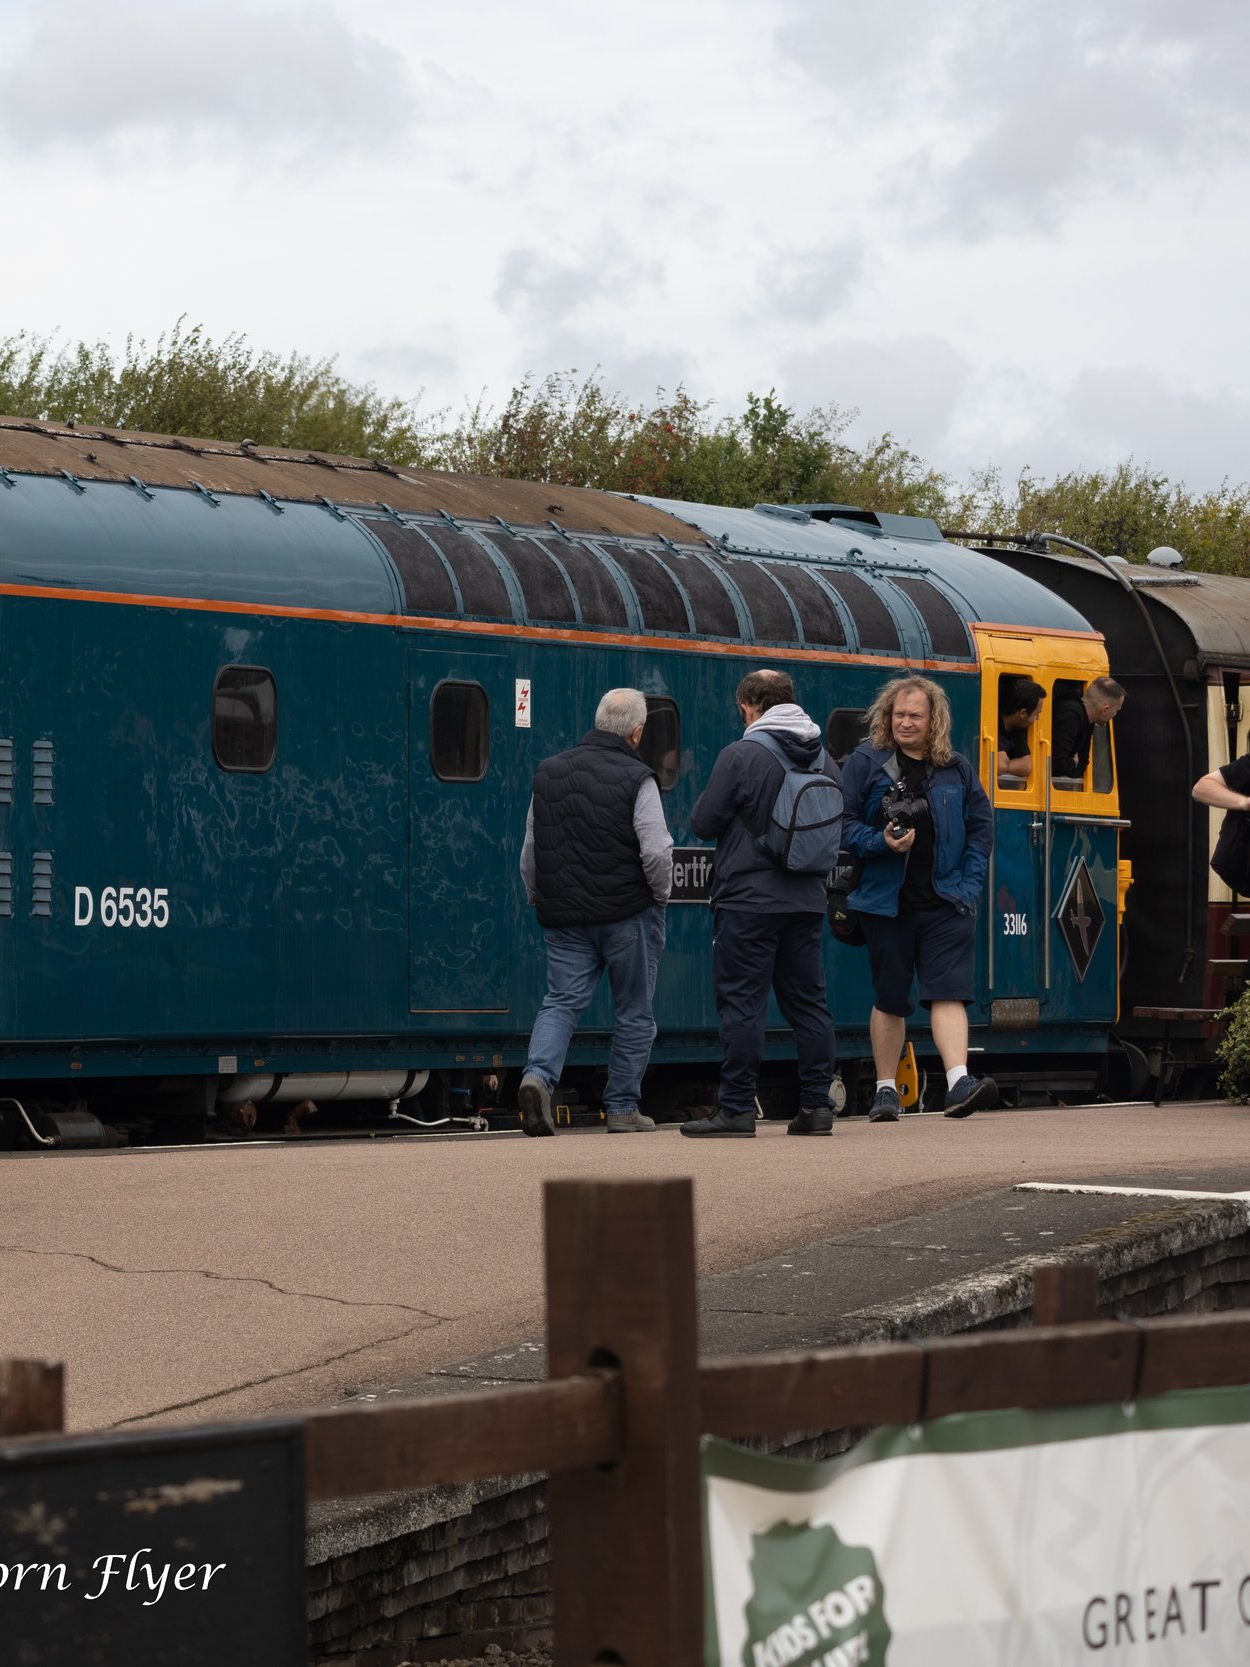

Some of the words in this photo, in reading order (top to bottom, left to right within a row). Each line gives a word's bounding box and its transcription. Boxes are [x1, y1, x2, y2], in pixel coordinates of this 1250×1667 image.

[672, 855, 713, 888] ertf
[74, 886, 94, 926] D
[100, 886, 170, 928] 6535
[1003, 913, 1027, 935] 33116
[752, 1613, 818, 1667] KIDS
[807, 1574, 876, 1639] FOR
[1081, 1579, 1222, 1651] GREAT
